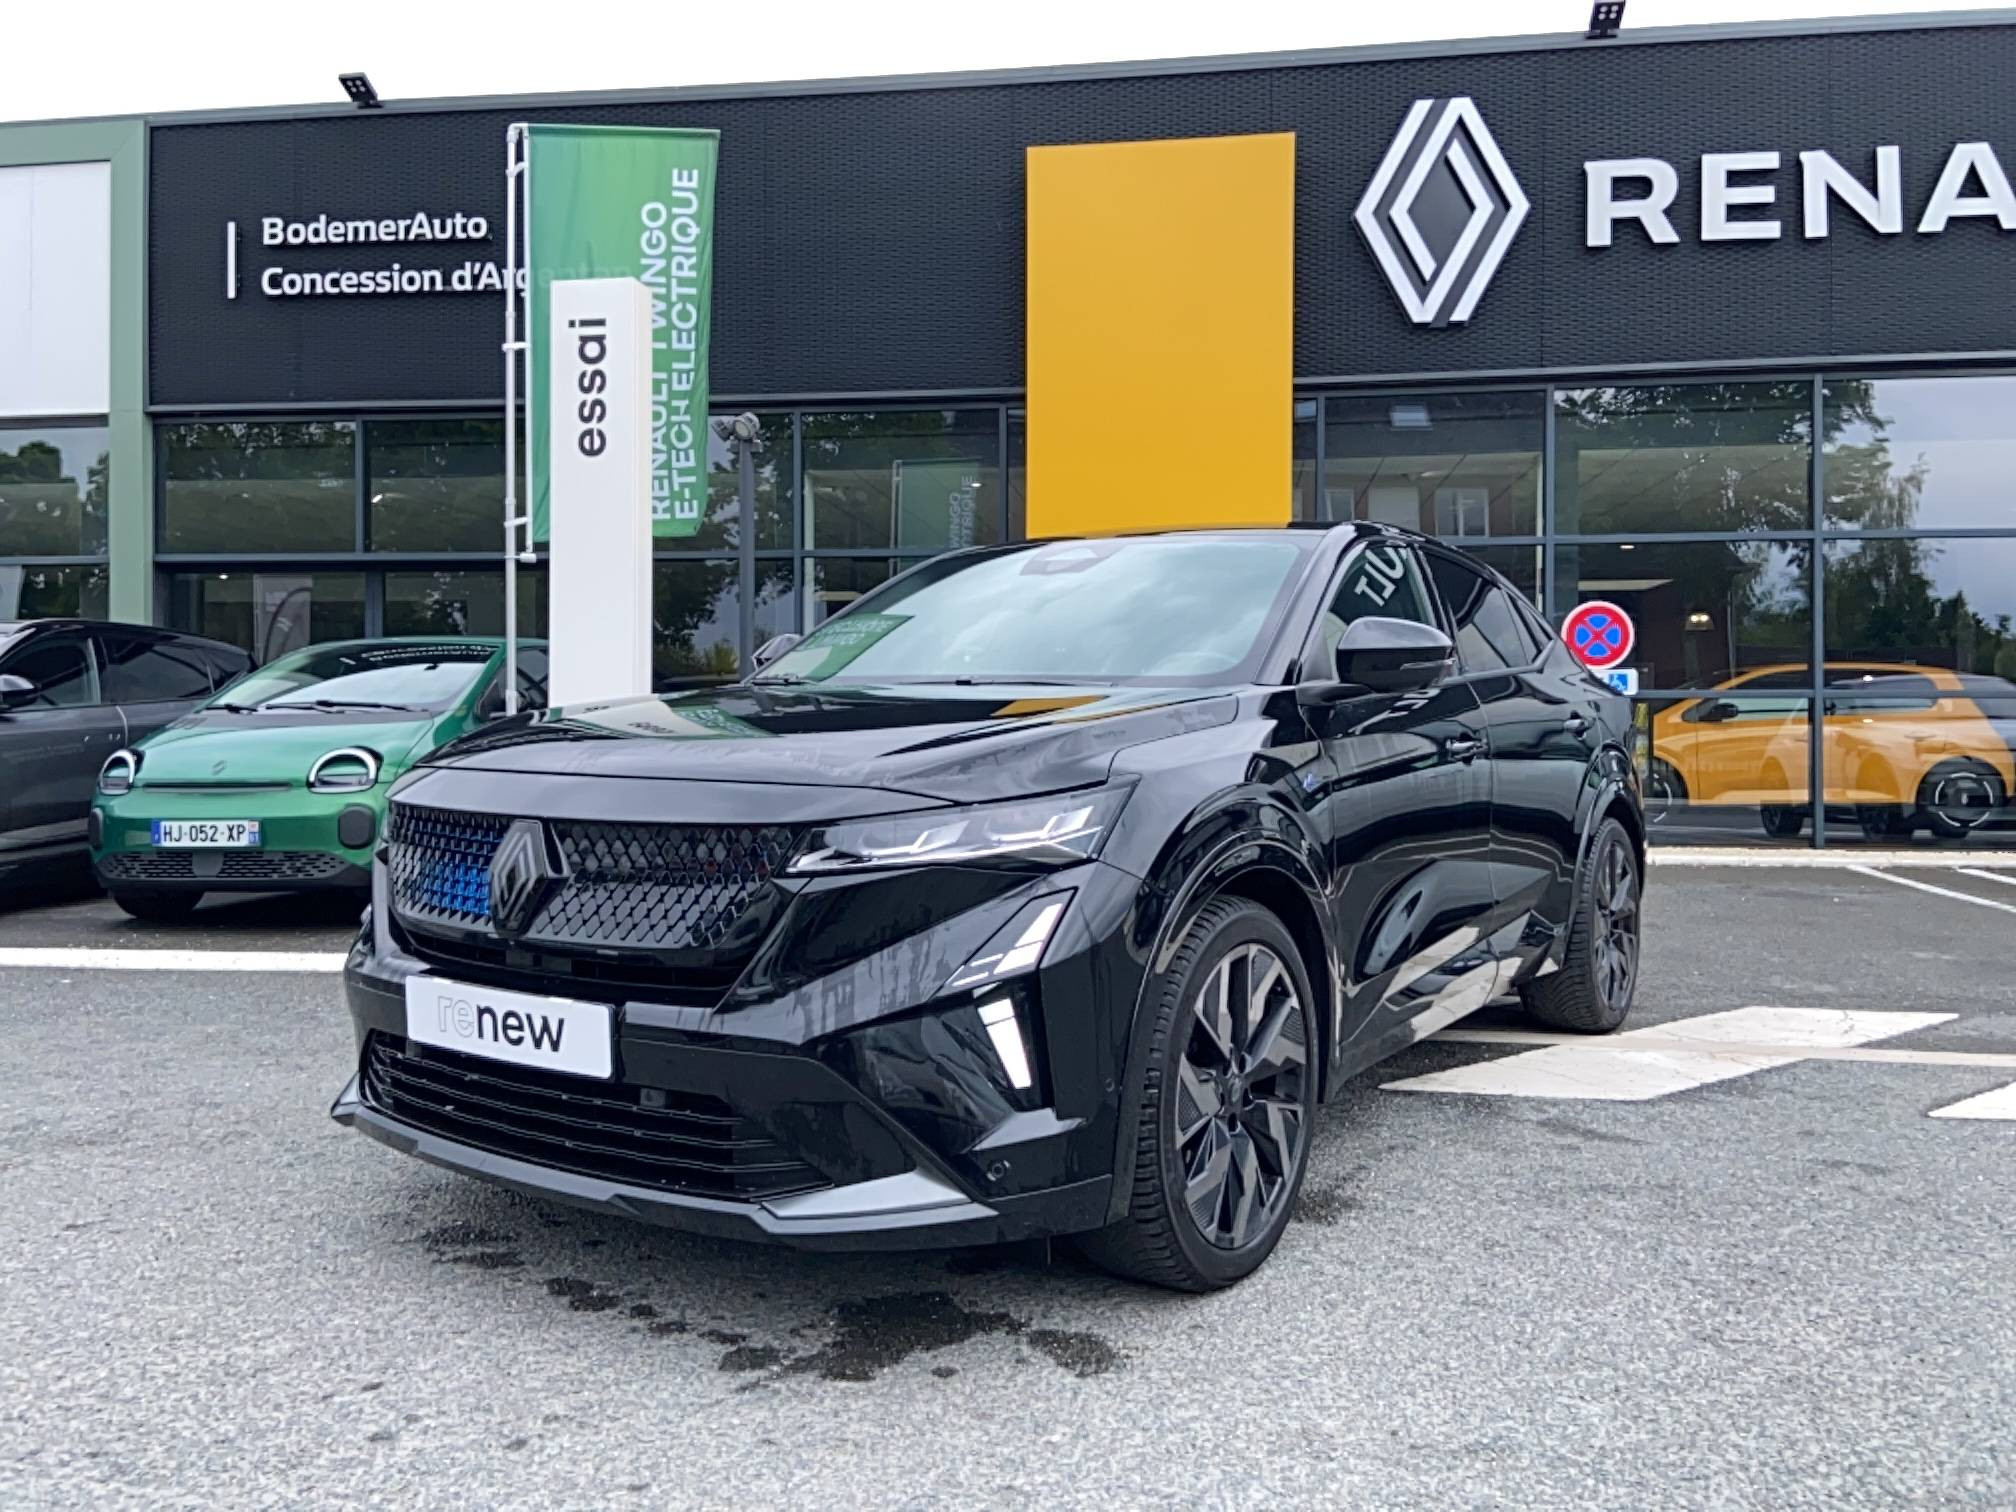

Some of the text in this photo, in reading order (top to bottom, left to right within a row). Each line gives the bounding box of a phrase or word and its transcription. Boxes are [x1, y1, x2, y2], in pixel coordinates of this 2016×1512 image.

[1583, 142, 2016, 248] RENA
[262, 212, 488, 245] BodemerAuto
[261, 263, 443, 296] Concession
[670, 168, 701, 520] E-TECH ELECTRIQUE
[568, 317, 607, 458] essai
[163, 824, 247, 842] HJ-052-XP
[437, 995, 565, 1052] renew
